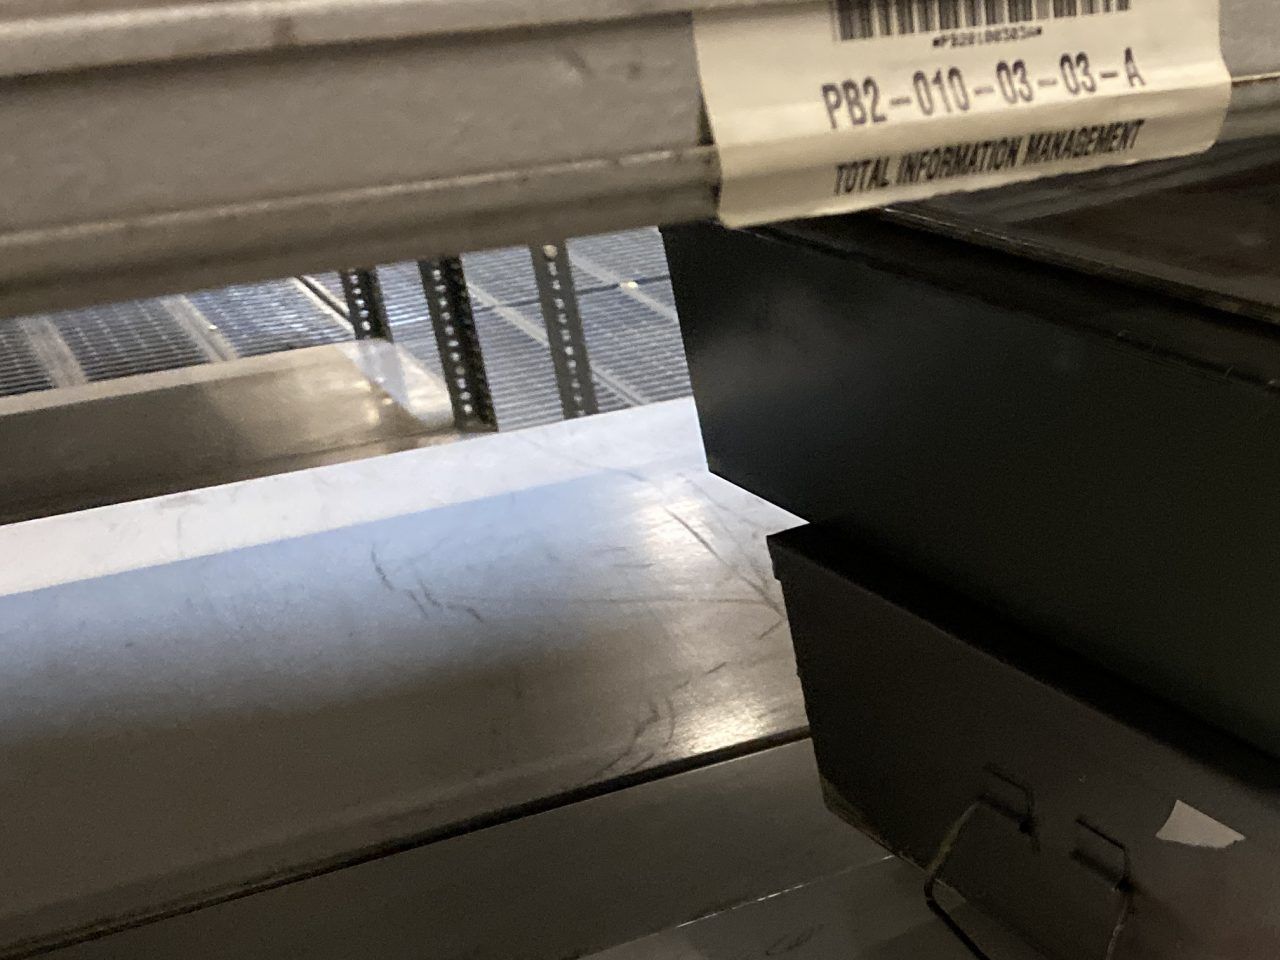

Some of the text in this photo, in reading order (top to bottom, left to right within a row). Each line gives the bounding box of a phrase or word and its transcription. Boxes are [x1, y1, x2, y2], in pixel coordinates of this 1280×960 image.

[821, 46, 1147, 130] PB2-010-03-03-A
[834, 118, 1146, 197] TOTAL INFORMATION MANAGEMENT
